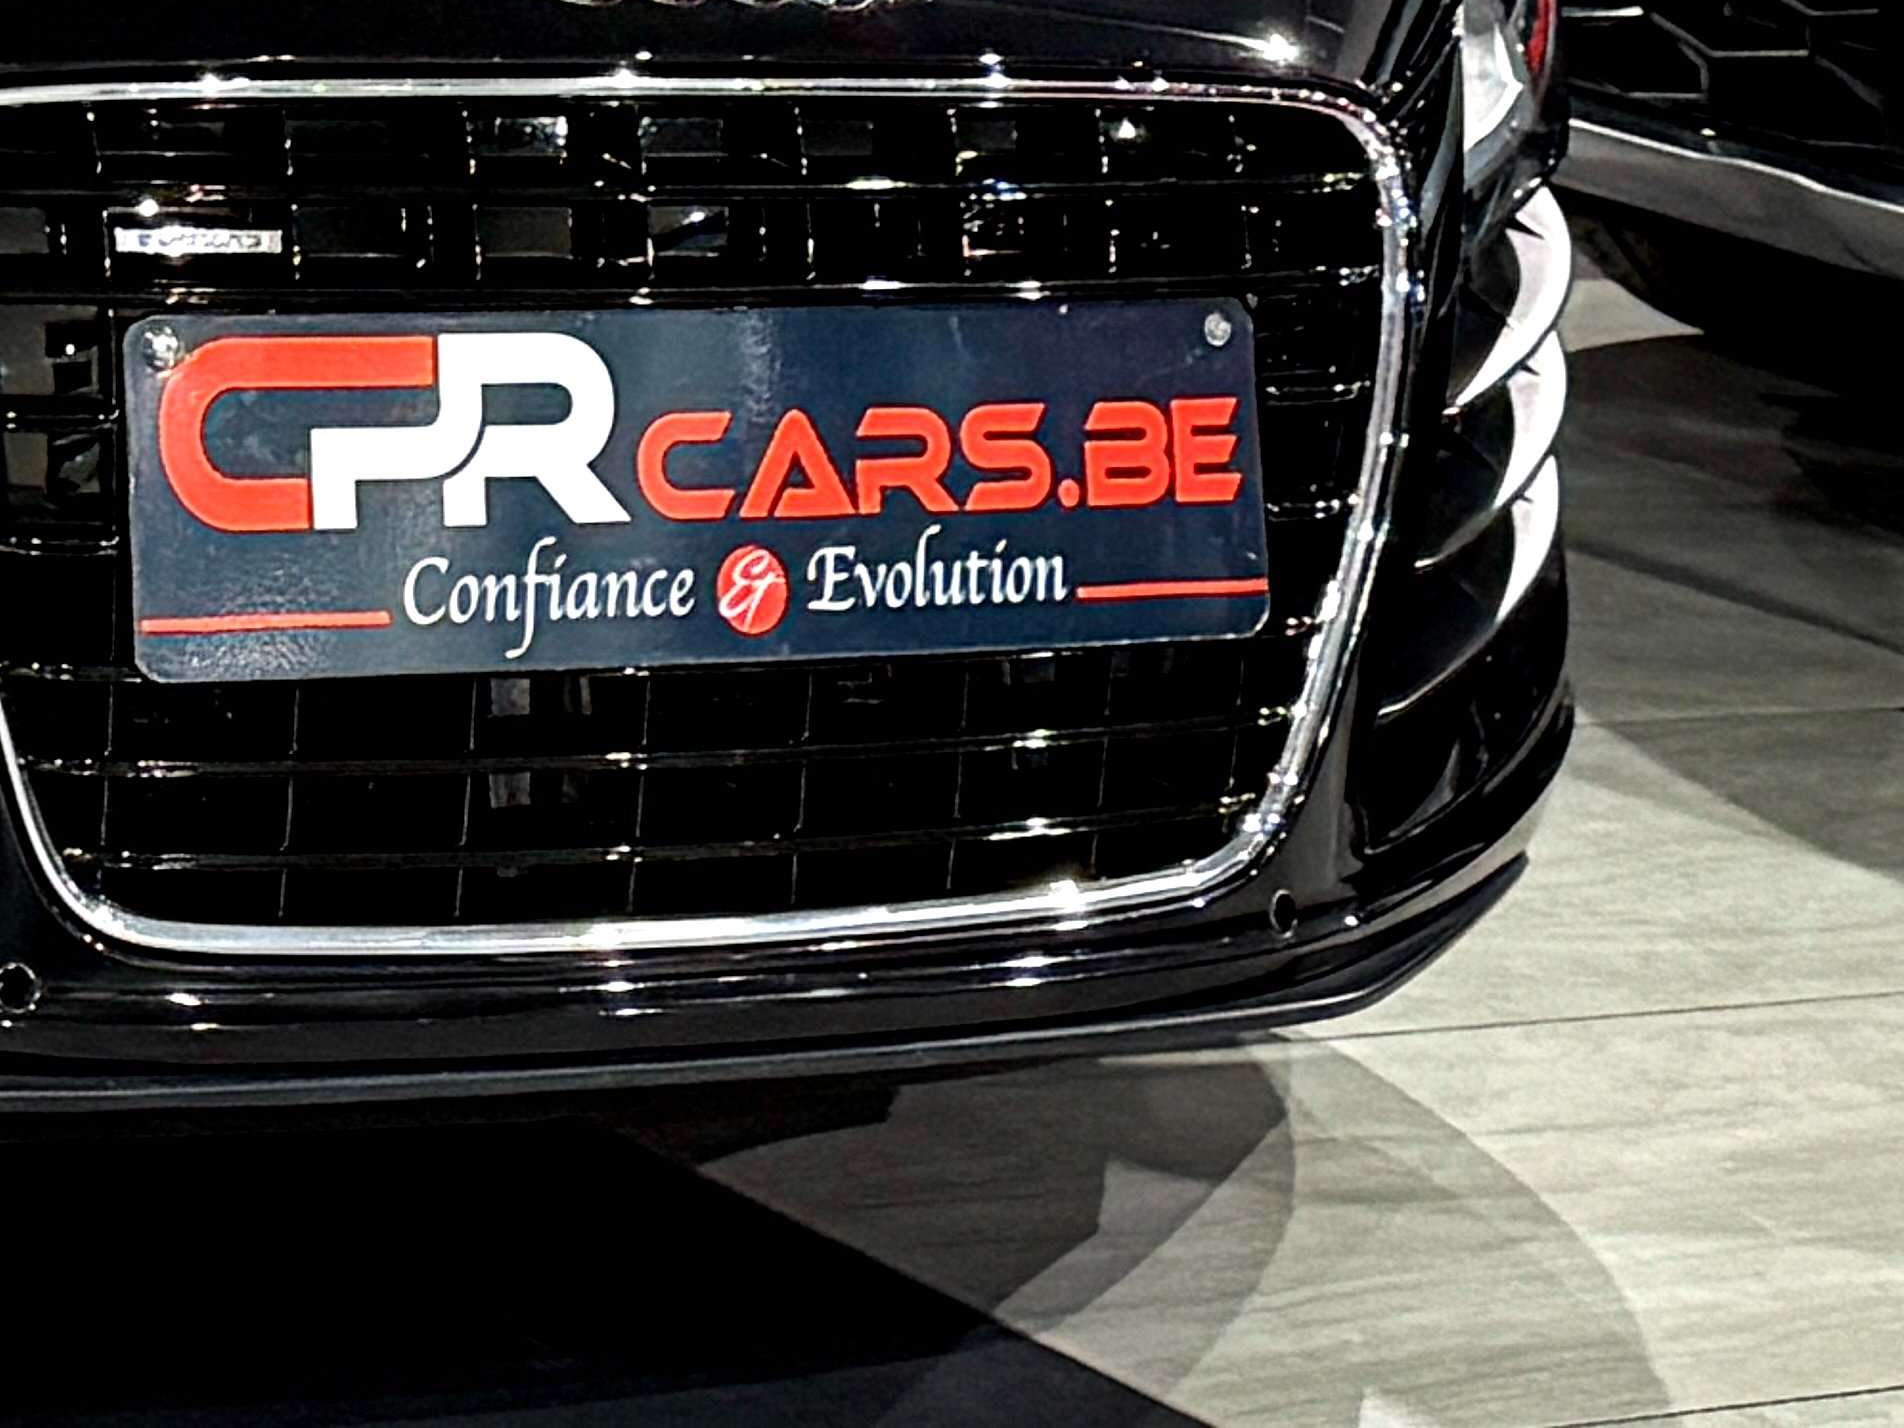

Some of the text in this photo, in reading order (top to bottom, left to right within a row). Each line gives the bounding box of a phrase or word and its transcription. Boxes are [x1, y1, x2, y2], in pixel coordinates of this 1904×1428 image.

[158, 331, 1243, 533] CPR CARS.BE
[403, 536, 695, 659] Confiance
[806, 524, 1070, 612] Evolution
